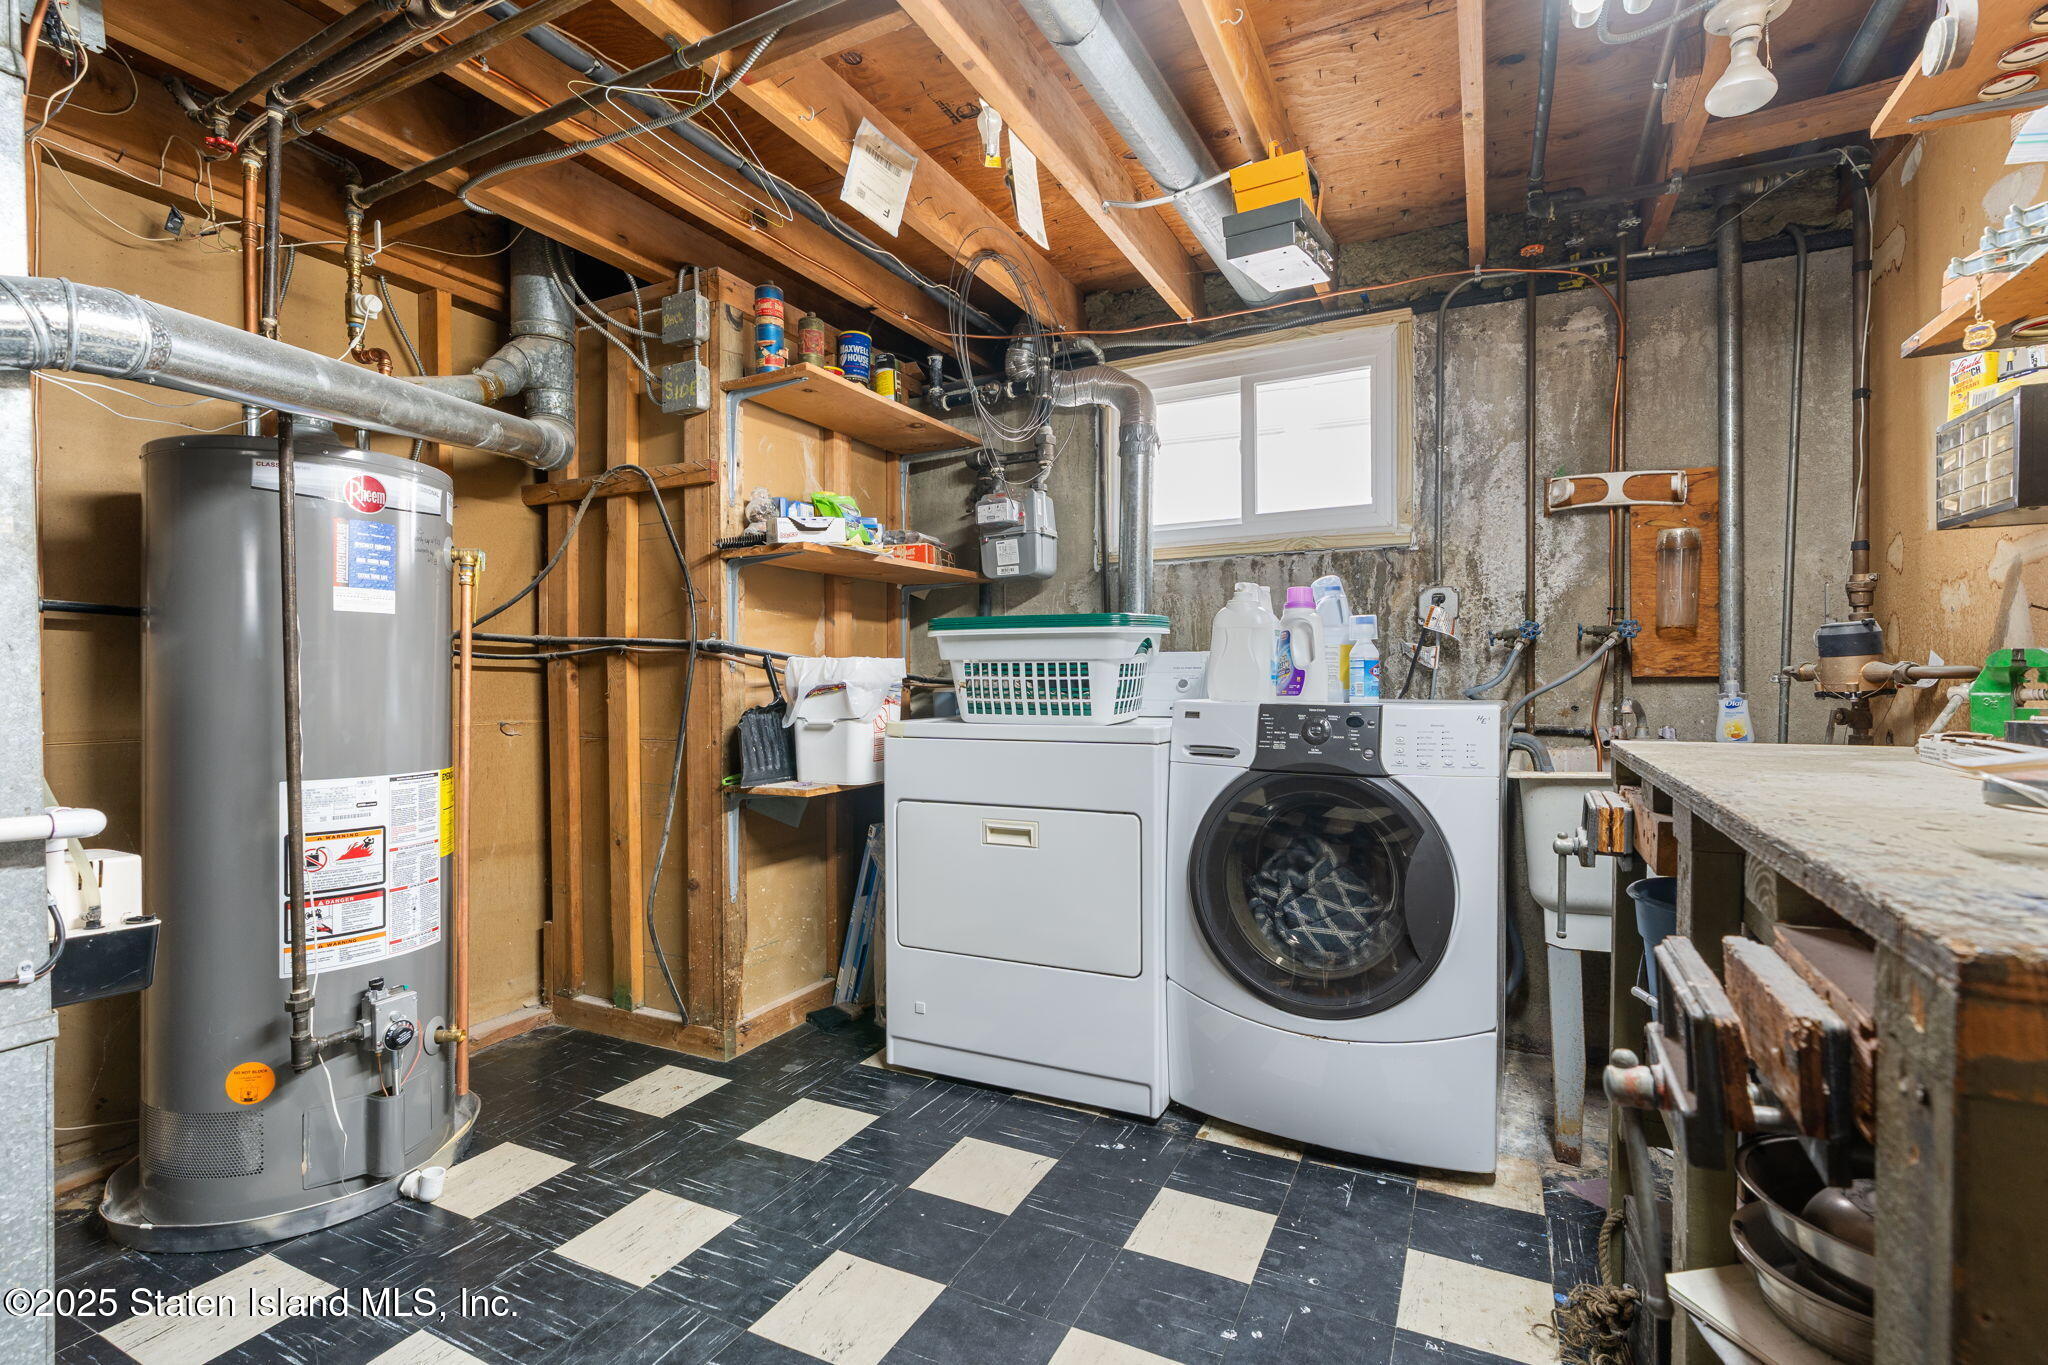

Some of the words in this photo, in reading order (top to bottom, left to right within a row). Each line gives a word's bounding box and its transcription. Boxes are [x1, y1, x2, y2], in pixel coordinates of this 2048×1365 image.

[840, 344, 869, 356] MAXWELL
[848, 354, 869, 364] HOUSE
[665, 380, 697, 400] SIDE
[349, 476, 385, 507] Rheem
[325, 832, 359, 841] WARNING
[325, 896, 355, 905] DANGER
[326, 938, 357, 947] WARNING
